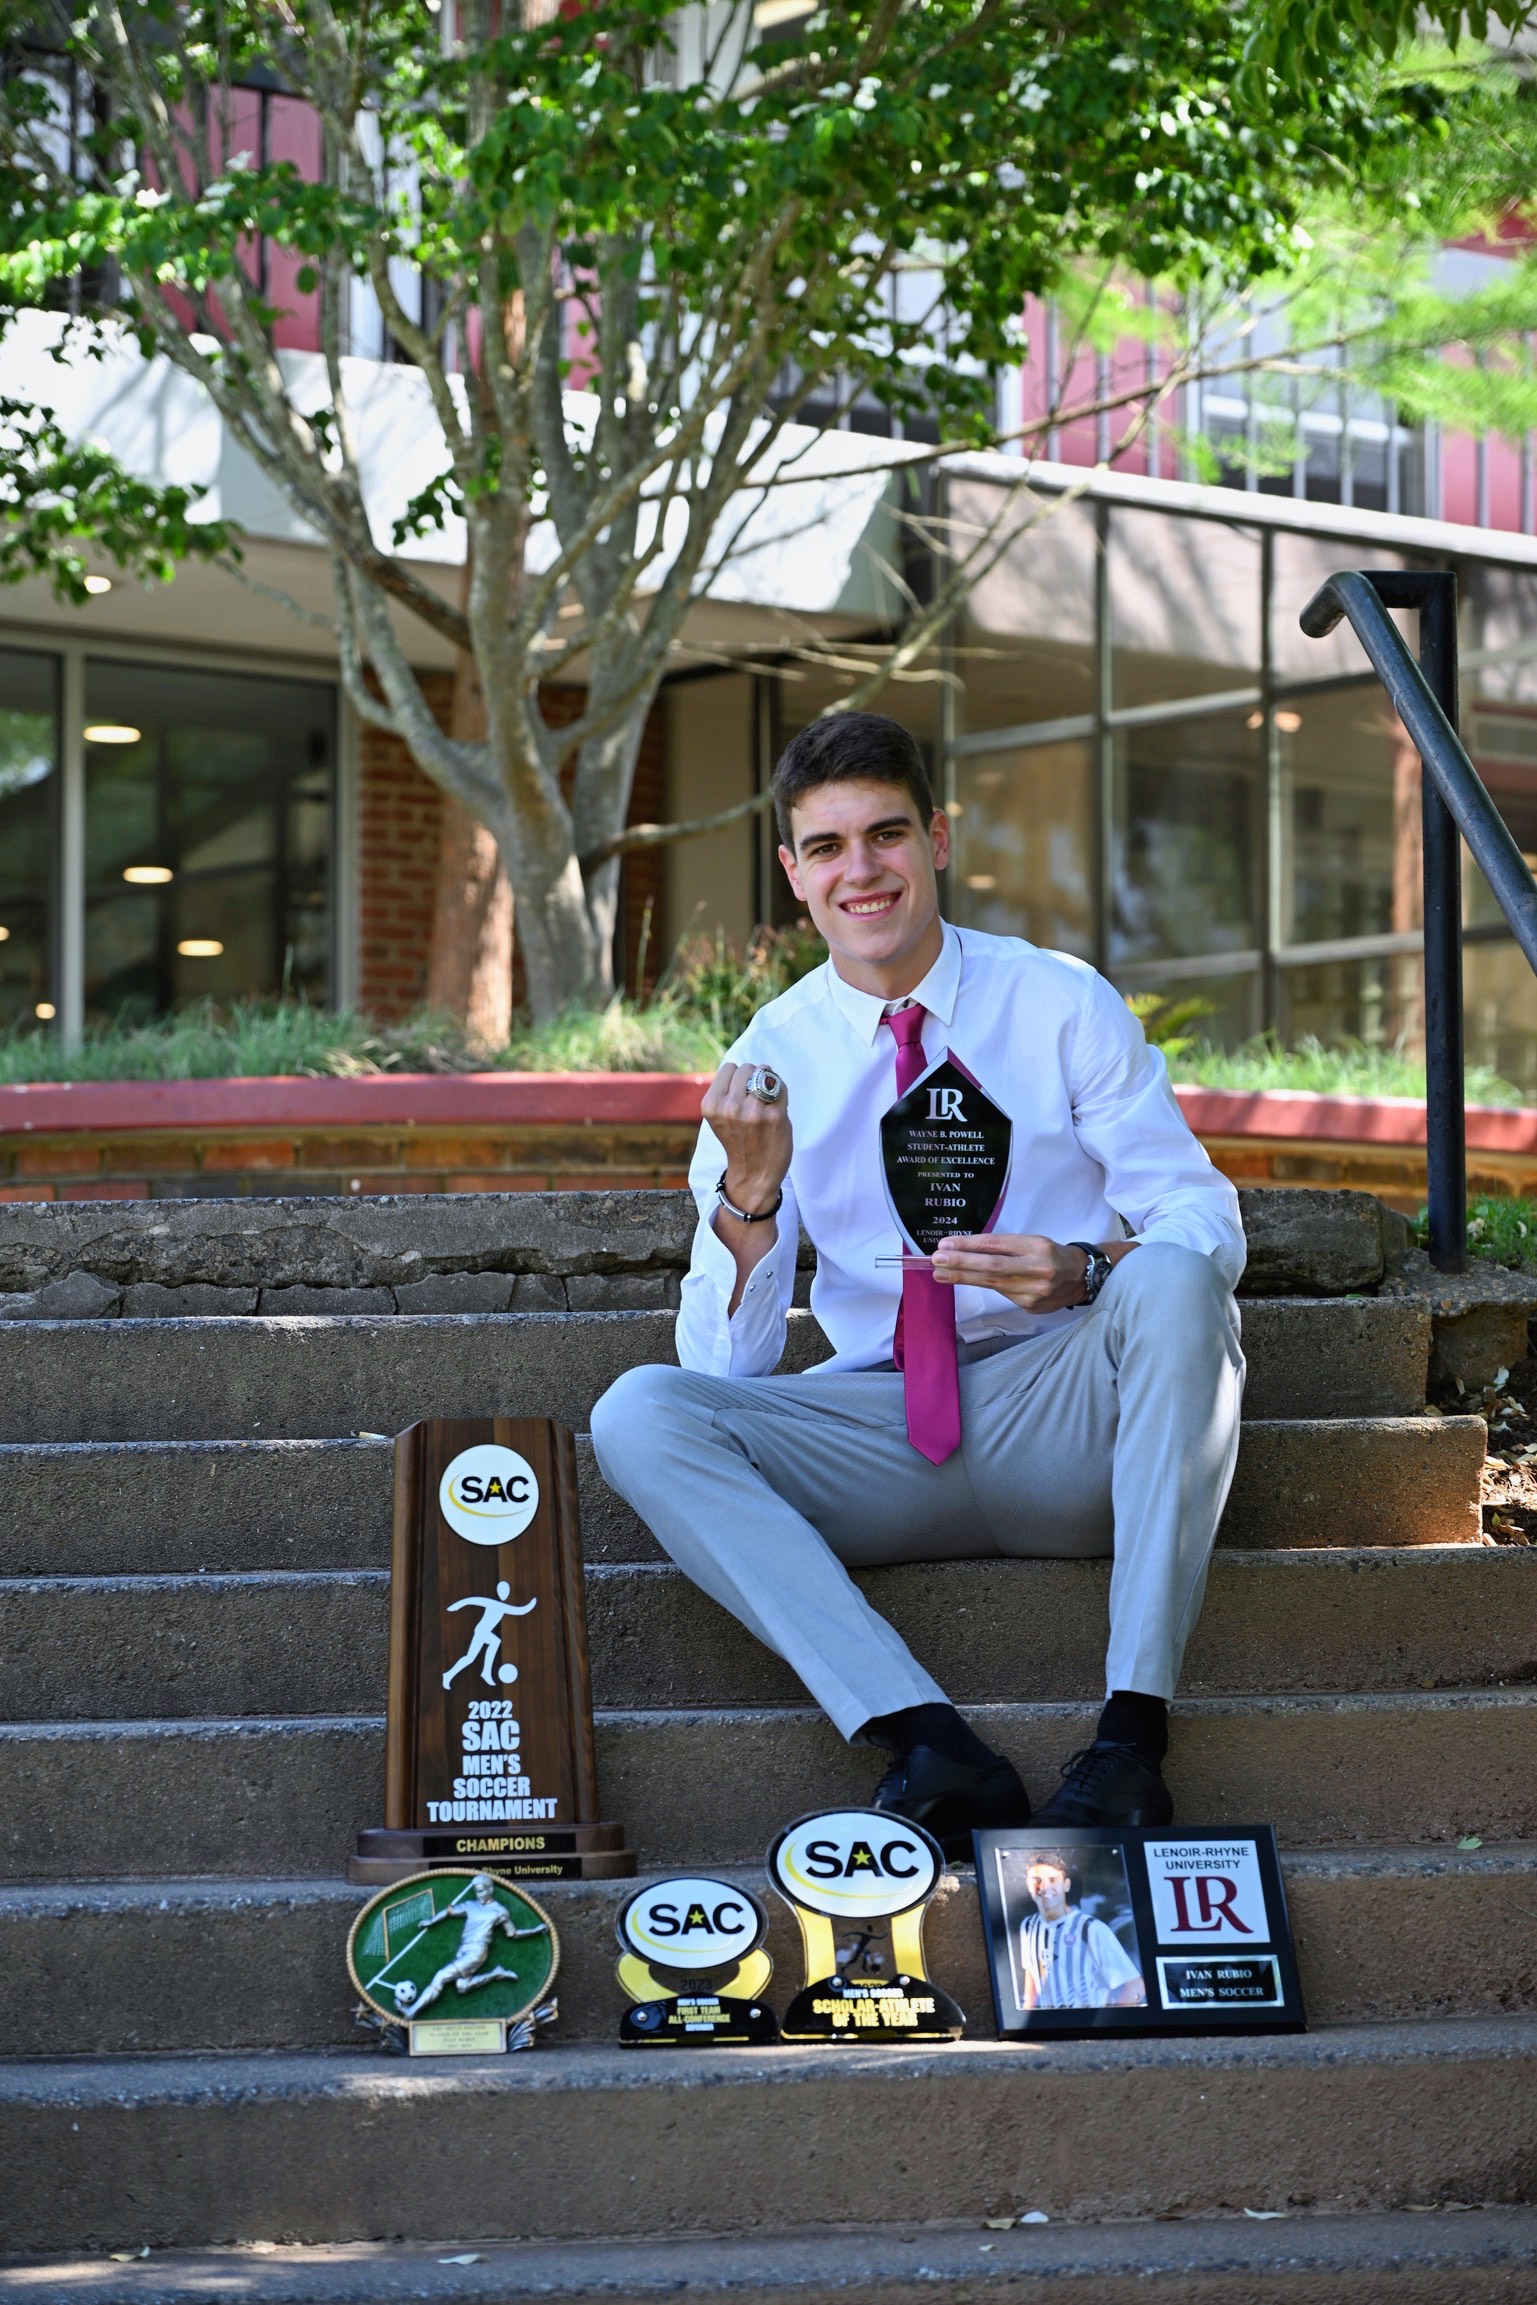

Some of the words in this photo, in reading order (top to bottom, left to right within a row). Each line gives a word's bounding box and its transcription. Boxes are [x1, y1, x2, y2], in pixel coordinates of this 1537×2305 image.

[909, 1130, 938, 1138] WAYNE
[940, 1130, 947, 1138] B.
[949, 1130, 984, 1139] POWELL
[907, 1143, 985, 1152] STUDENT-ATHLETE
[897, 1156, 926, 1164] AWARD
[928, 1156, 939, 1164] OF
[941, 1157, 995, 1165] EXCELLENCE
[930, 1183, 961, 1192] IVAN
[925, 1198, 966, 1208] RUBIO
[932, 1216, 958, 1225] 2024
[461, 1476, 530, 1504] SAC
[468, 1700, 513, 1720] 2022
[461, 1720, 520, 1751] SAC
[462, 1754, 521, 1776] MEN'S
[453, 1776, 531, 1799] SOCCER
[427, 1798, 558, 1823] TOURNAMENT
[456, 1836, 546, 1853] CHAMPIONS
[1154, 1847, 1249, 1857] LENOIR-RHYNE
[804, 1840, 920, 1879] SAC
[1166, 1860, 1240, 1870] UNIVERSITY
[514, 1864, 563, 1876] University
[649, 1902, 745, 1937] SAC
[1186, 1969, 1212, 1980] IVAN
[1217, 1969, 1252, 1979] RUBIO
[680, 1979, 713, 1991] 2023
[843, 1988, 869, 1998] MEN'S
[870, 1988, 904, 1998] SOCCER
[1180, 1987, 1214, 1998] MEN'S
[1219, 1987, 1264, 1997] SOCCER
[677, 2006, 698, 2016] FIRST
[700, 2005, 721, 2015] TEAM
[813, 1998, 935, 2014] SCHOLAR-ATHLETE
[668, 2014, 731, 2024] ALL-CONFERENCE
[832, 2012, 850, 2027] OF
[853, 2012, 880, 2027] THE
[881, 2012, 918, 2027] YEAR
